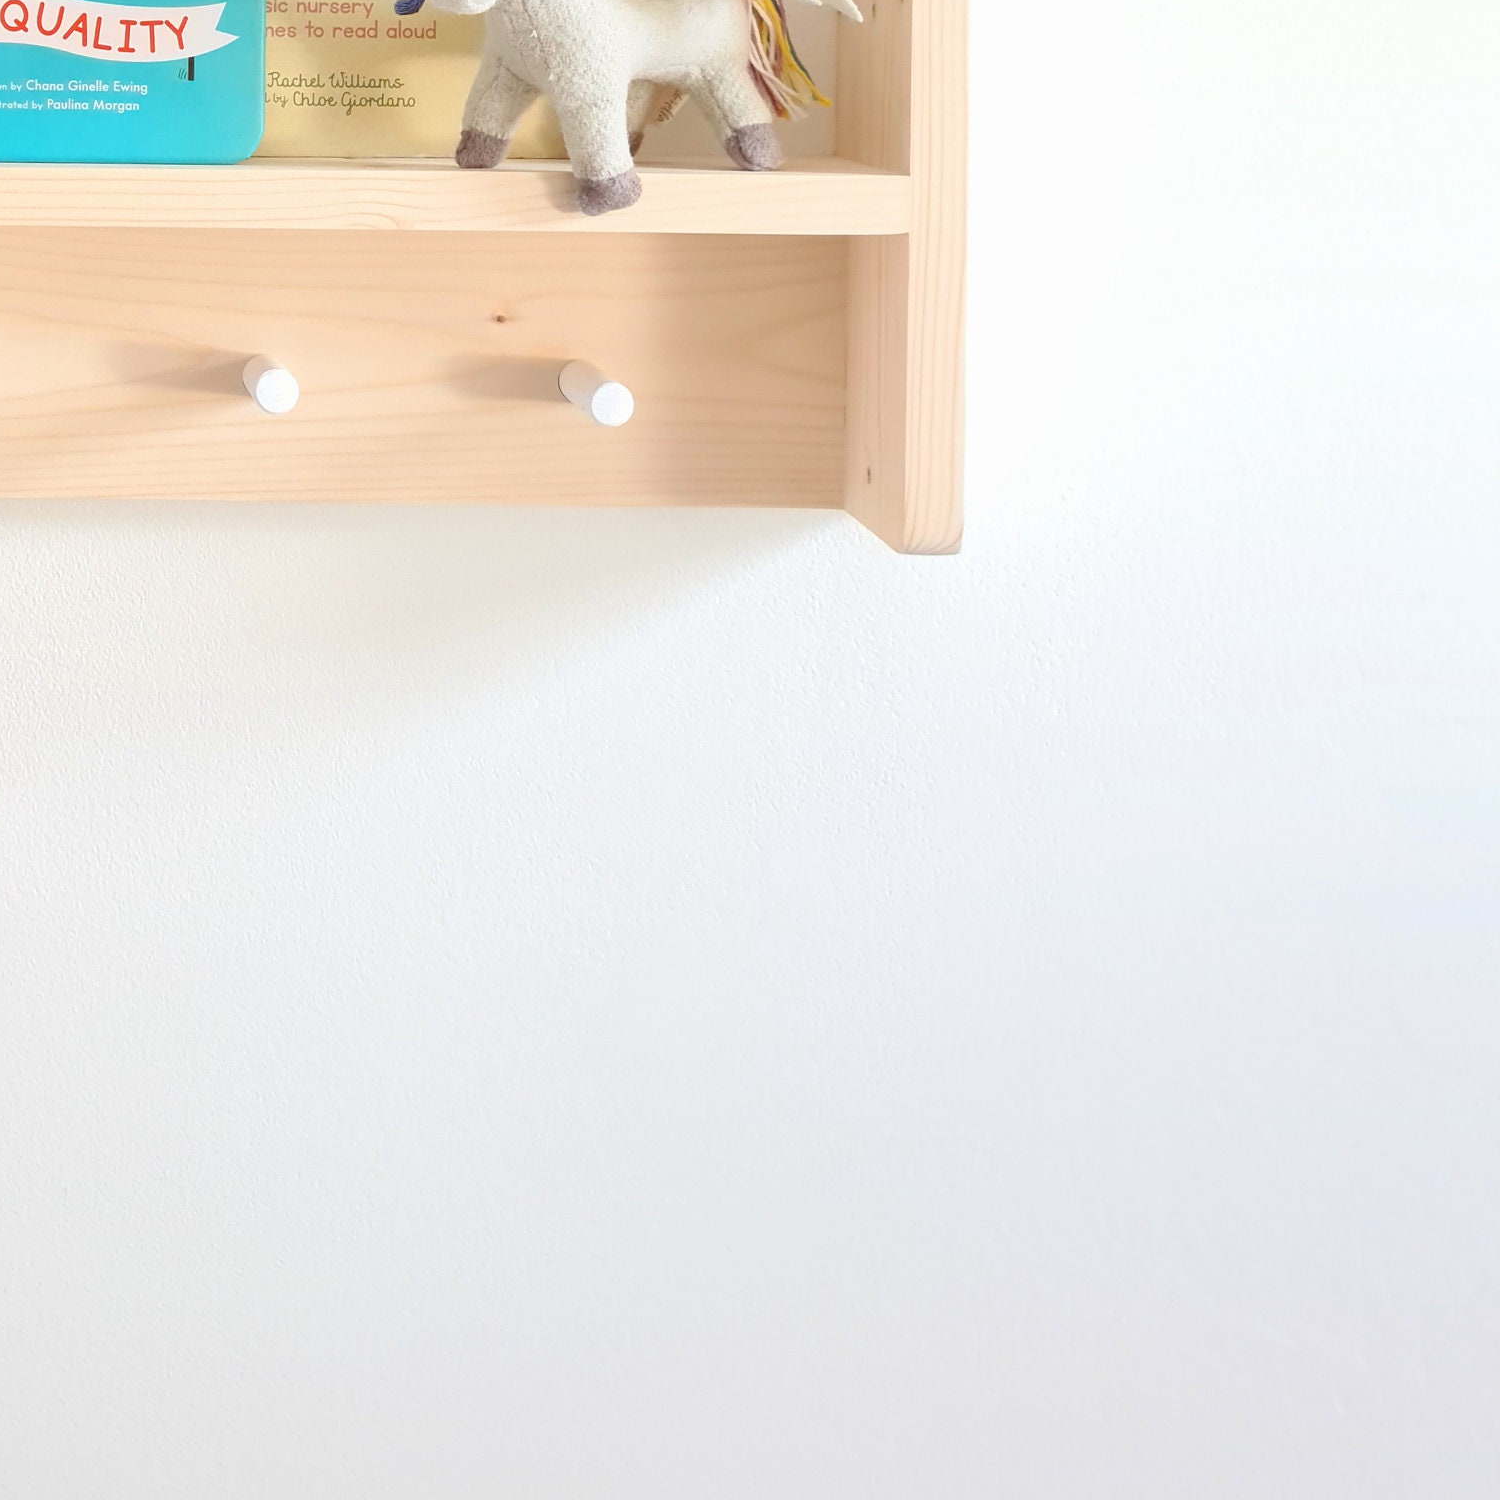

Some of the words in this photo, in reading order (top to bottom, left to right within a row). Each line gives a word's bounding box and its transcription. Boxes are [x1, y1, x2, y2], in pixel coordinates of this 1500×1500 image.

[296, 1, 374, 19] nursery
[305, 19, 325, 39] to
[332, 19, 379, 39] read
[386, 19, 437, 40] aloud
[10, 81, 23, 93] by
[25, 79, 65, 92] Chana
[67, 80, 109, 92] Ginelle
[113, 80, 149, 96] Ewing
[267, 71, 326, 89] Rachel
[328, 71, 405, 89] Williams
[31, 99, 44, 111] by
[46, 97, 90, 111] Paulina
[92, 99, 140, 114] Morgan
[272, 92, 289, 109] by
[292, 90, 338, 107] Chloe
[340, 90, 417, 116] Giordano
